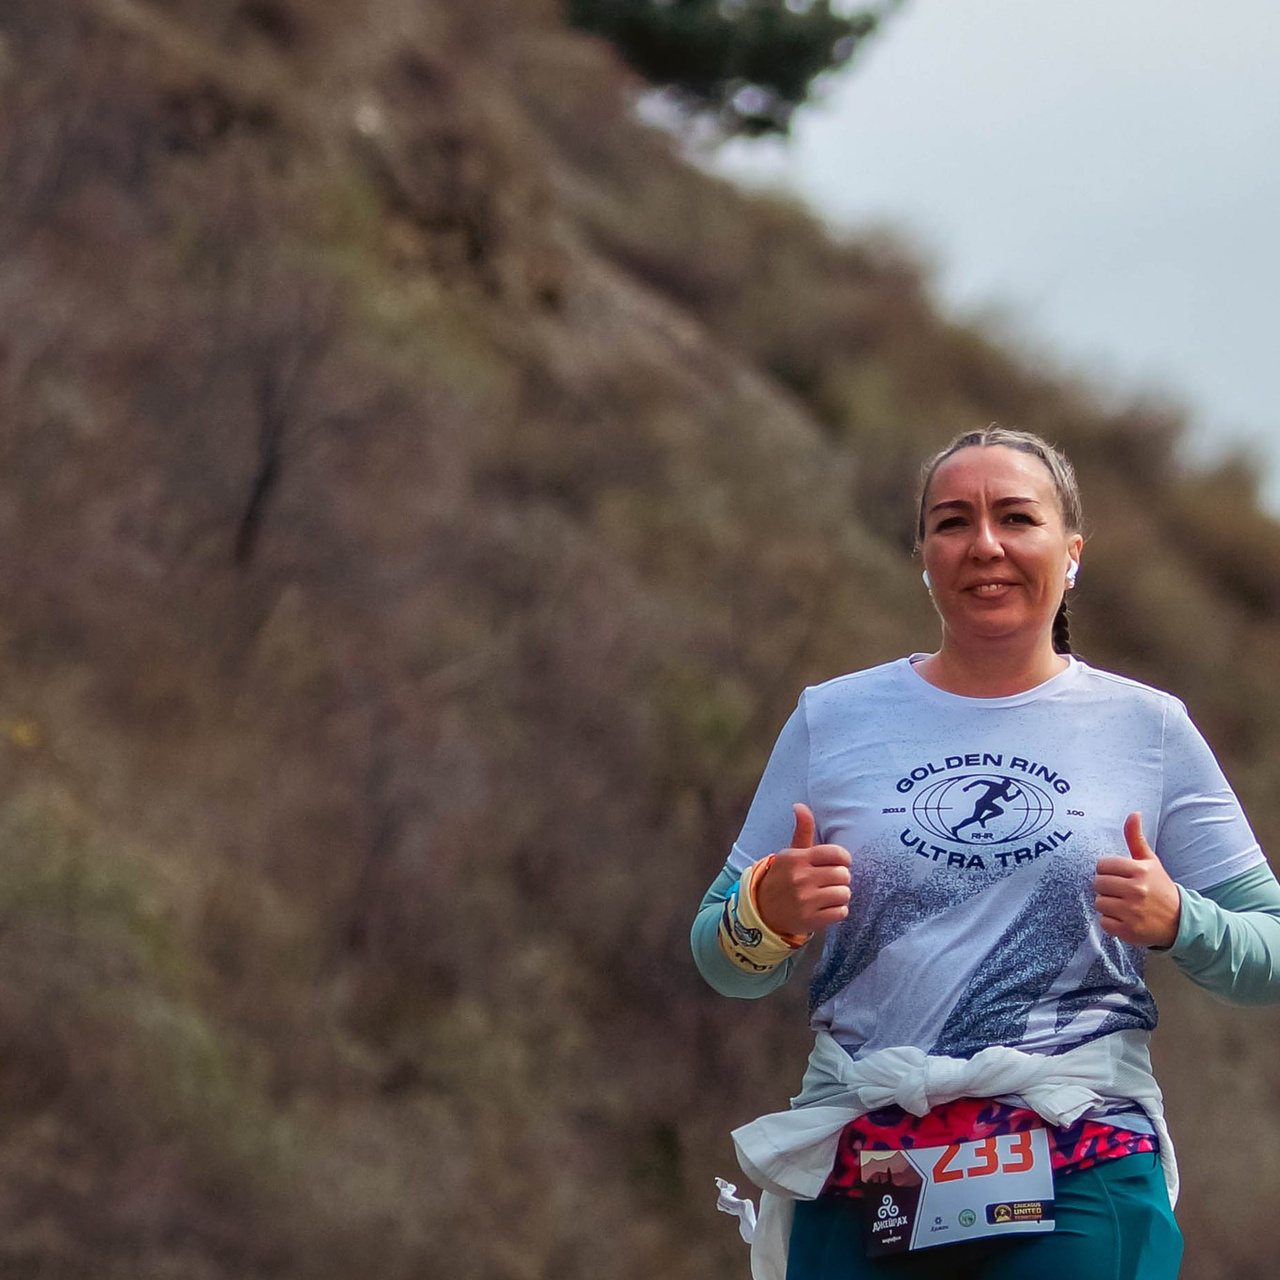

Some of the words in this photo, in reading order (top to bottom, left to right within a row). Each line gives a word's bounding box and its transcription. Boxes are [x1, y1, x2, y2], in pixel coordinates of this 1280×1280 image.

[896, 753, 1003, 794] GOLDEN
[1009, 756, 1071, 795] RING
[1066, 809, 1085, 817] 100
[900, 828, 985, 869] ULTRA
[994, 829, 1074, 868] TRAIL
[932, 1131, 1035, 1184] 233
[1013, 1207, 1042, 1215] UNITED
